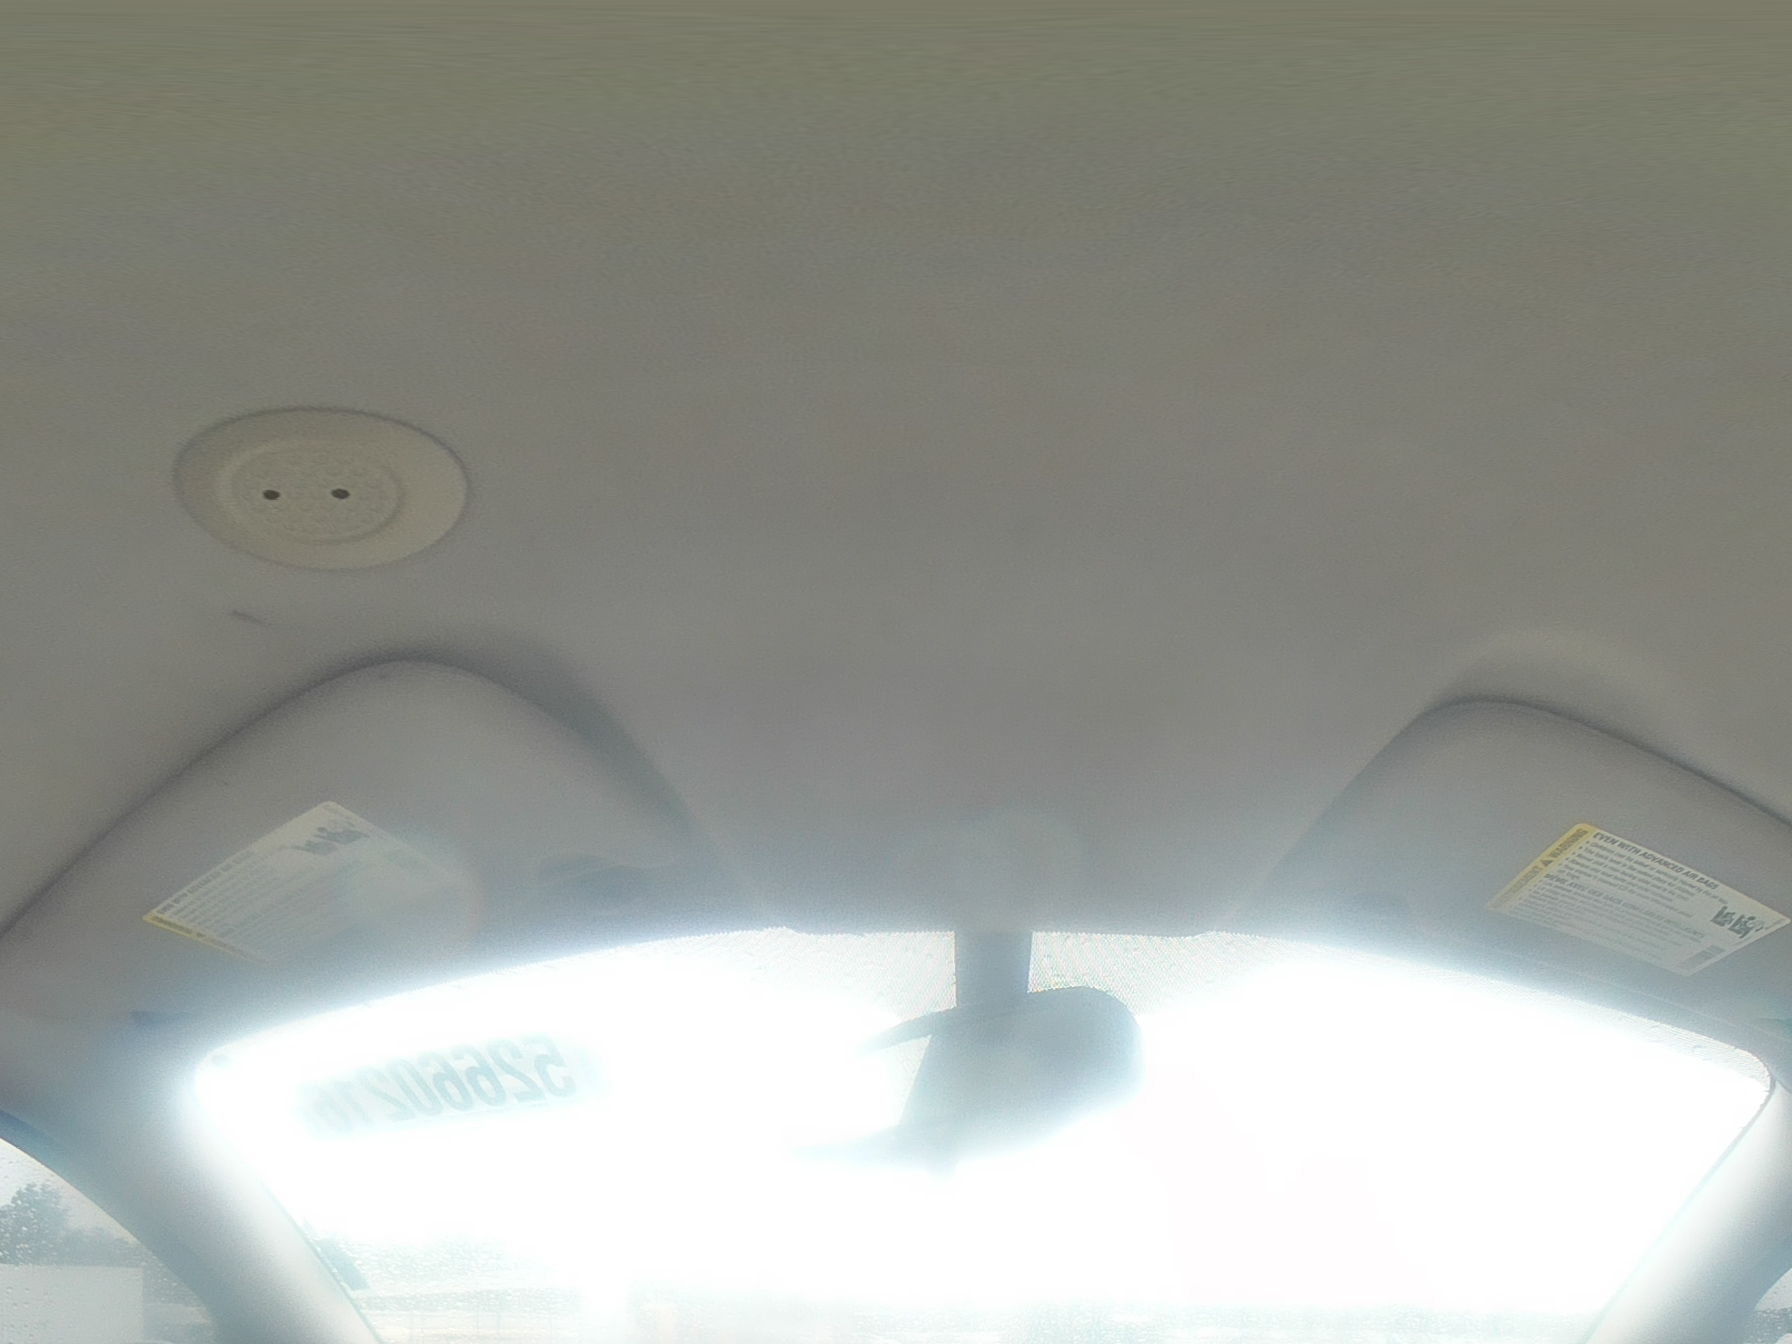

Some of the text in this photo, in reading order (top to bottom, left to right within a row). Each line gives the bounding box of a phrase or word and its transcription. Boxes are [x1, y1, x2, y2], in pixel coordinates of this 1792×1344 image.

[1593, 831, 1618, 846] EVEN
[1617, 841, 1641, 854] WITH
[1639, 852, 1684, 874] ADVANCED
[1682, 870, 1700, 882] AIR
